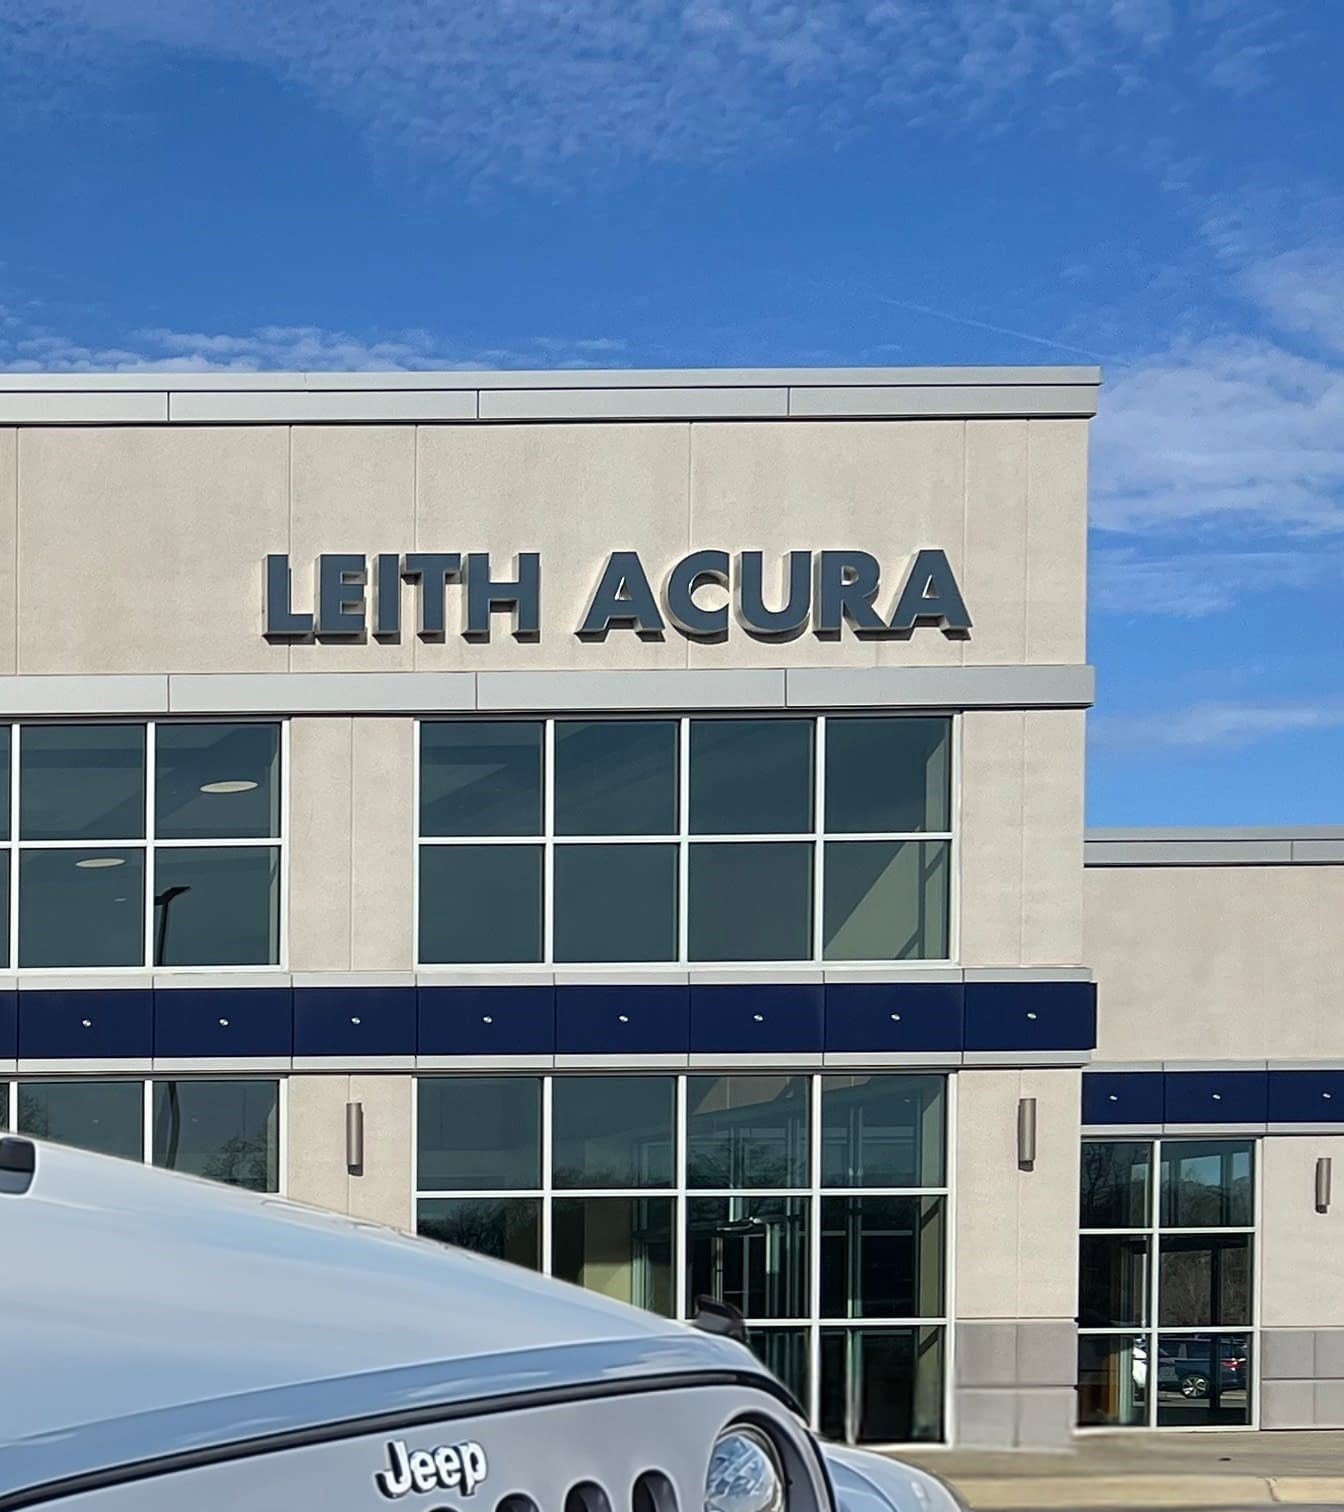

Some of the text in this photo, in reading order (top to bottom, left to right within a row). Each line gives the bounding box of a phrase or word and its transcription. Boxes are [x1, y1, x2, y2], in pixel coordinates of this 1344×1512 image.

[263, 549, 973, 643] LEITH ACURA
[375, 1440, 488, 1499] Jeep
